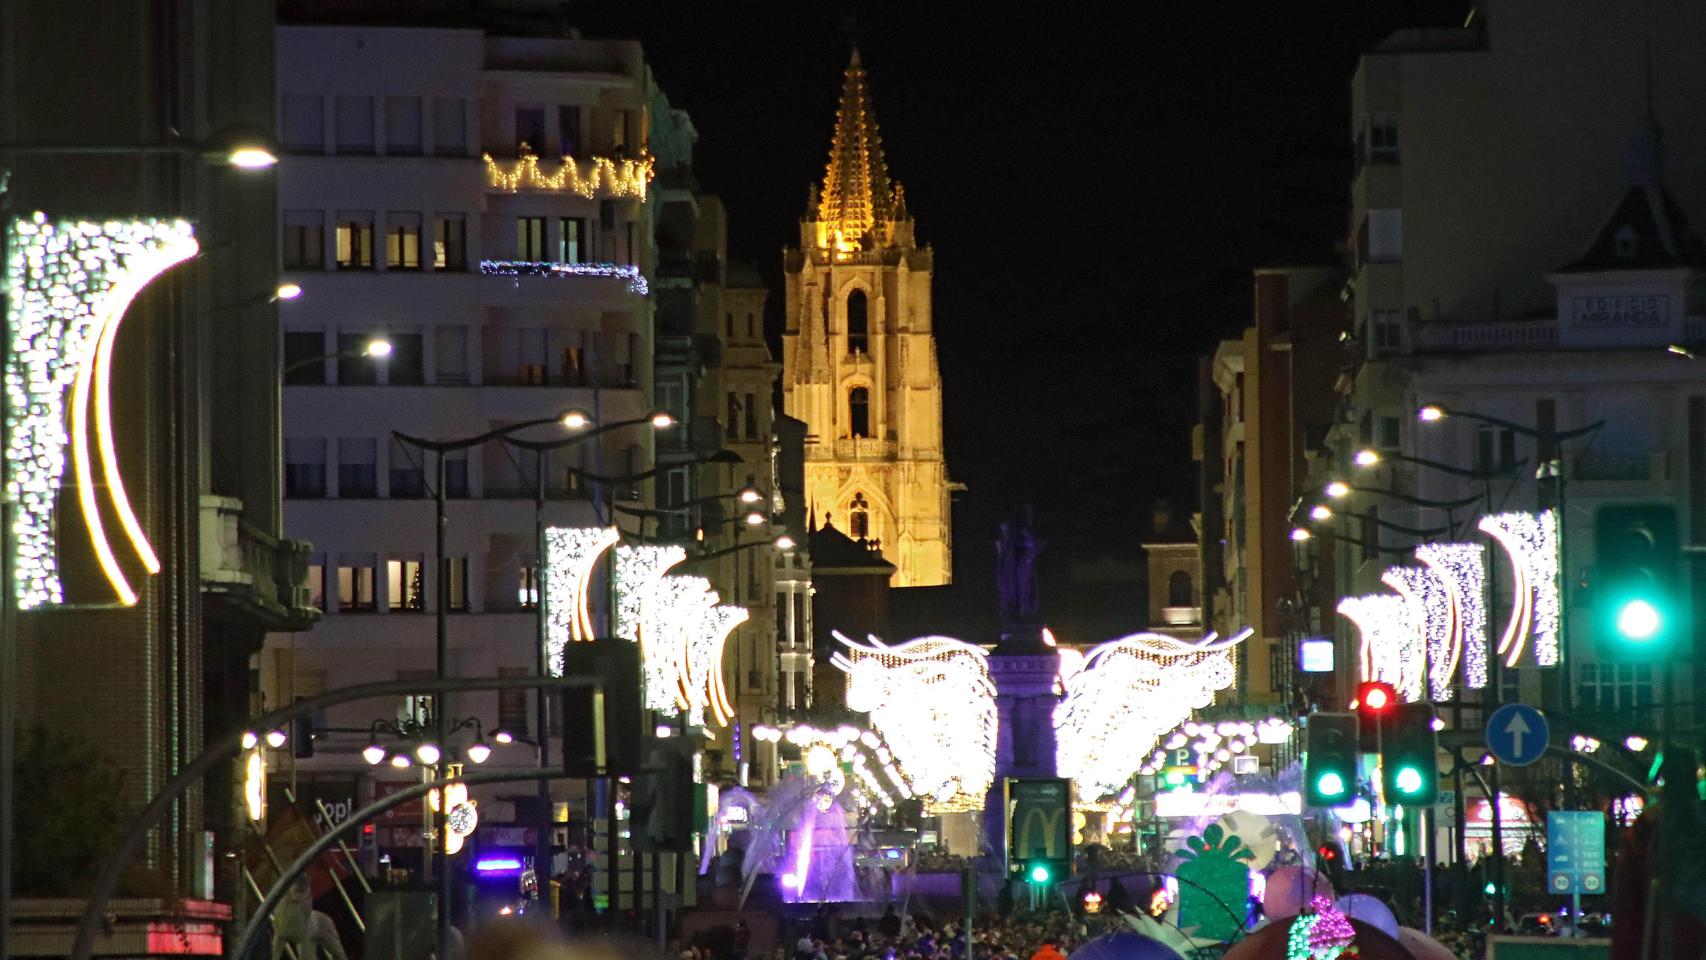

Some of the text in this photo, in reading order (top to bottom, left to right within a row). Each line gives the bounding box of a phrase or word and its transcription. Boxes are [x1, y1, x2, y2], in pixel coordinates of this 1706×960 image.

[1586, 299, 1657, 311] EDIFICIO
[1583, 311, 1659, 323] MIRANDA
[1176, 748, 1189, 766] P
